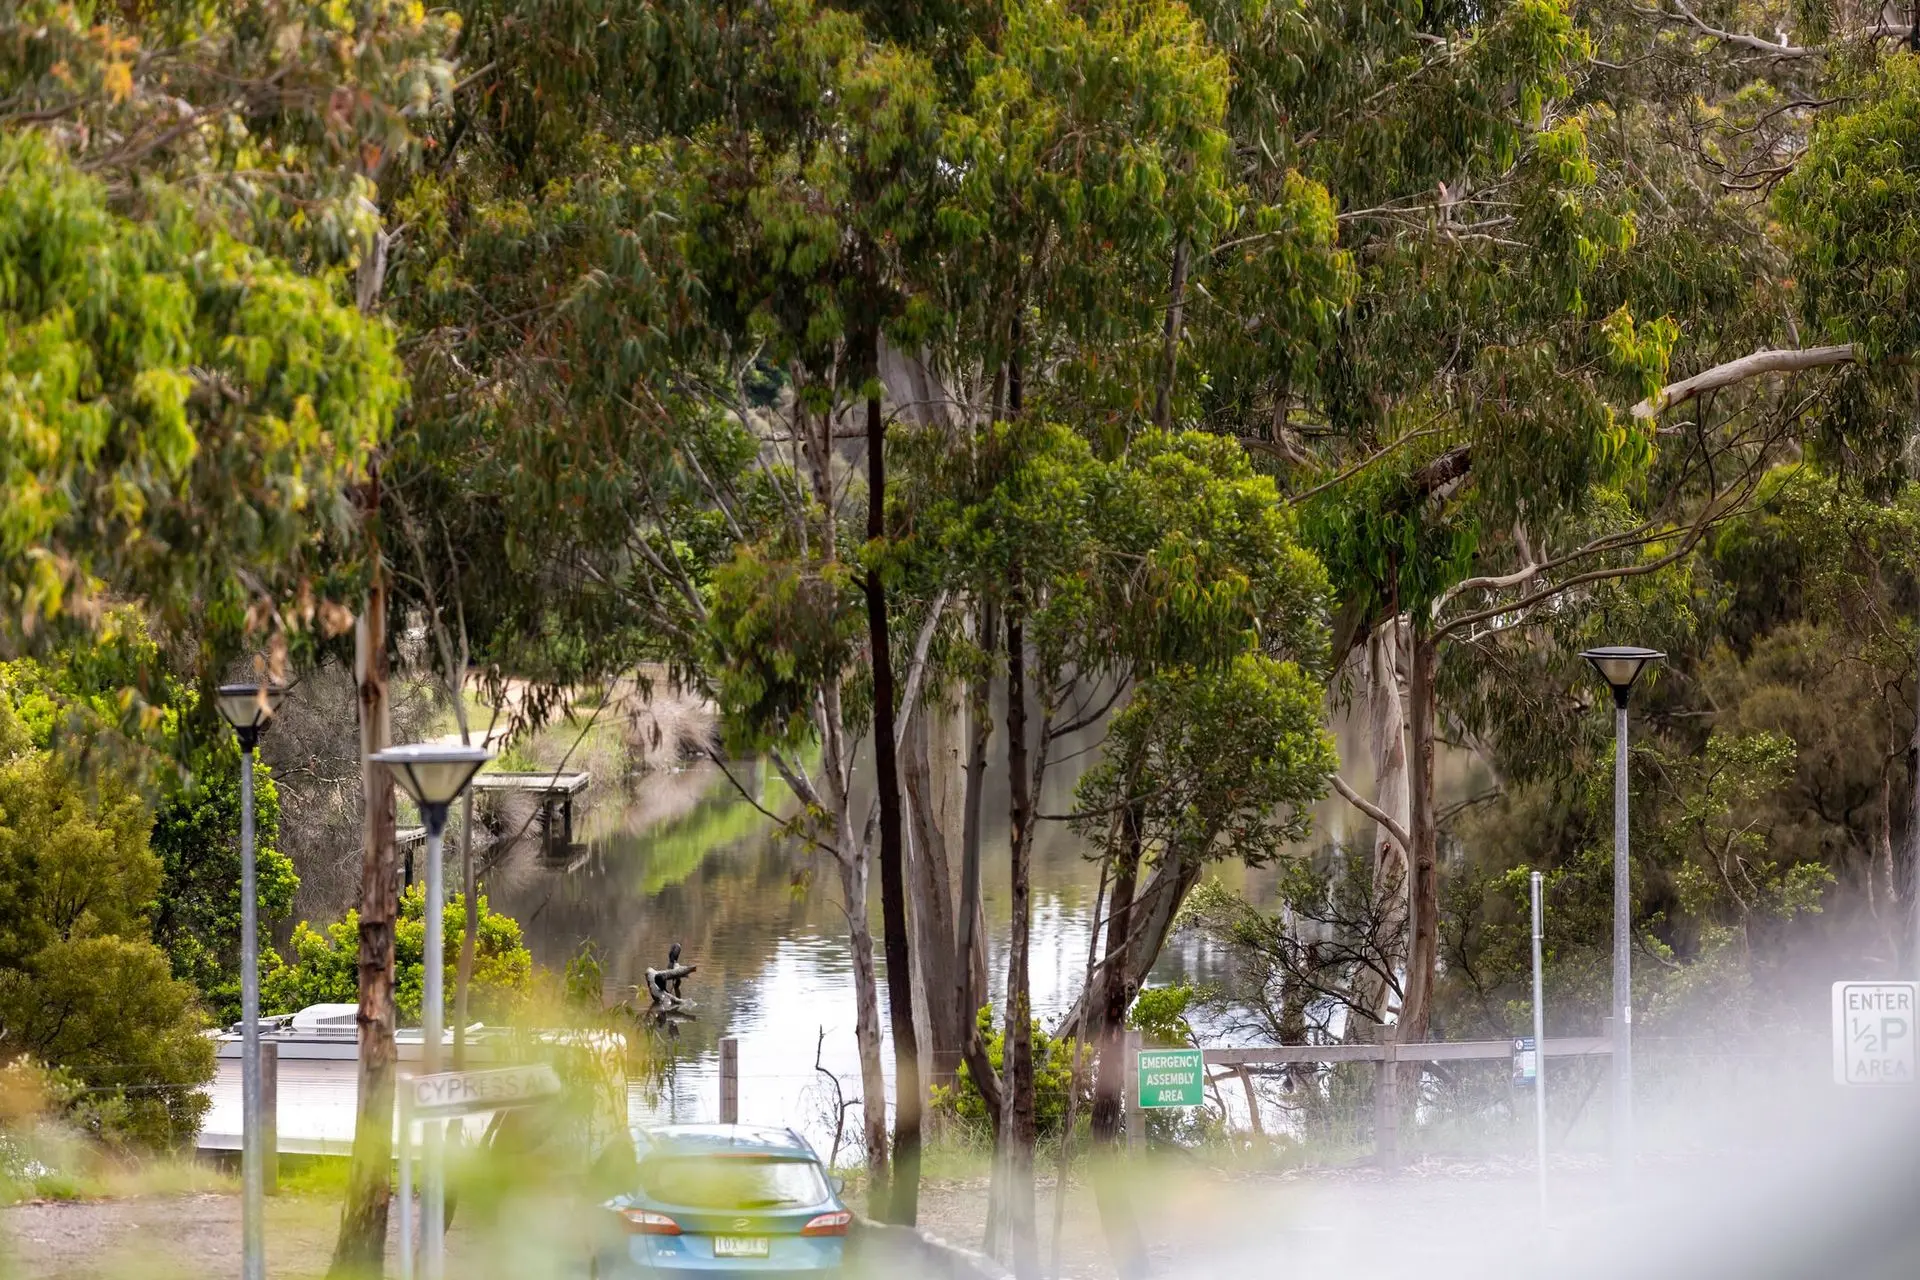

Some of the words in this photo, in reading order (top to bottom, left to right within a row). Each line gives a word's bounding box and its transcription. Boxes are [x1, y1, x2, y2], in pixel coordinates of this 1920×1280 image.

[1849, 993, 1909, 1010] ENTER
[1141, 1055, 1199, 1069] EMERGENCY
[1855, 1059, 1908, 1076] AREA
[1146, 1072, 1195, 1086] ASSEMBLY
[417, 1074, 519, 1103] CYPRESS
[1158, 1089, 1184, 1102] AREA
